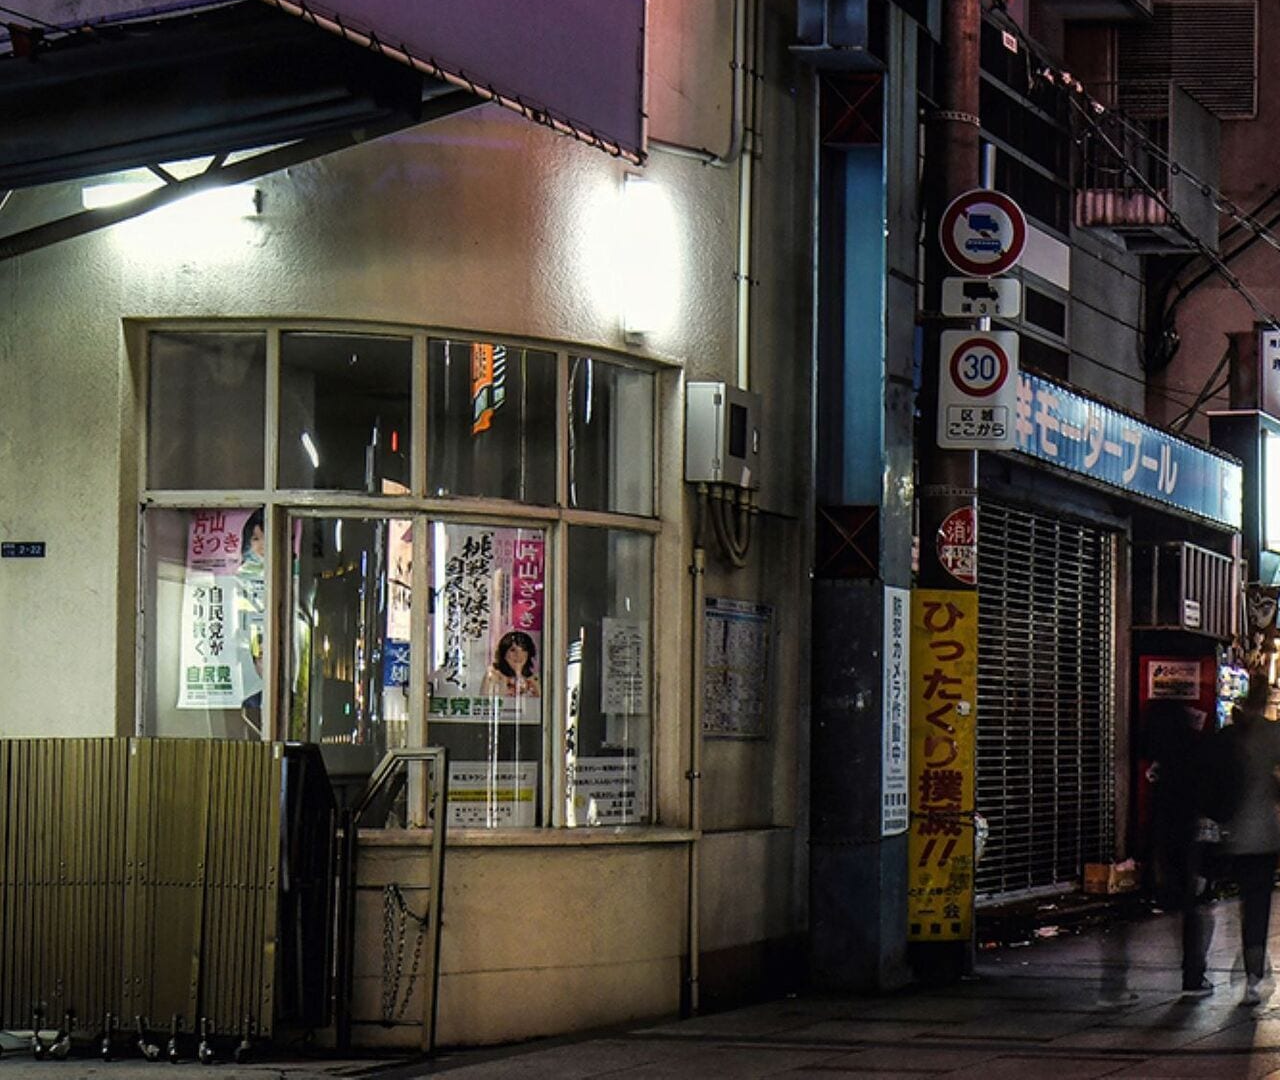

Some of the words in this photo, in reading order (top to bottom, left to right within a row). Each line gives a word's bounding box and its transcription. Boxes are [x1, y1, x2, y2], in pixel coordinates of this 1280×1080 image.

[963, 354, 995, 381] 30
[949, 423, 1004, 437] ここから
[192, 508, 227, 535] 片山
[191, 531, 241, 555] さつき
[208, 586, 225, 656] 自民党が
[186, 666, 232, 683] 自民党
